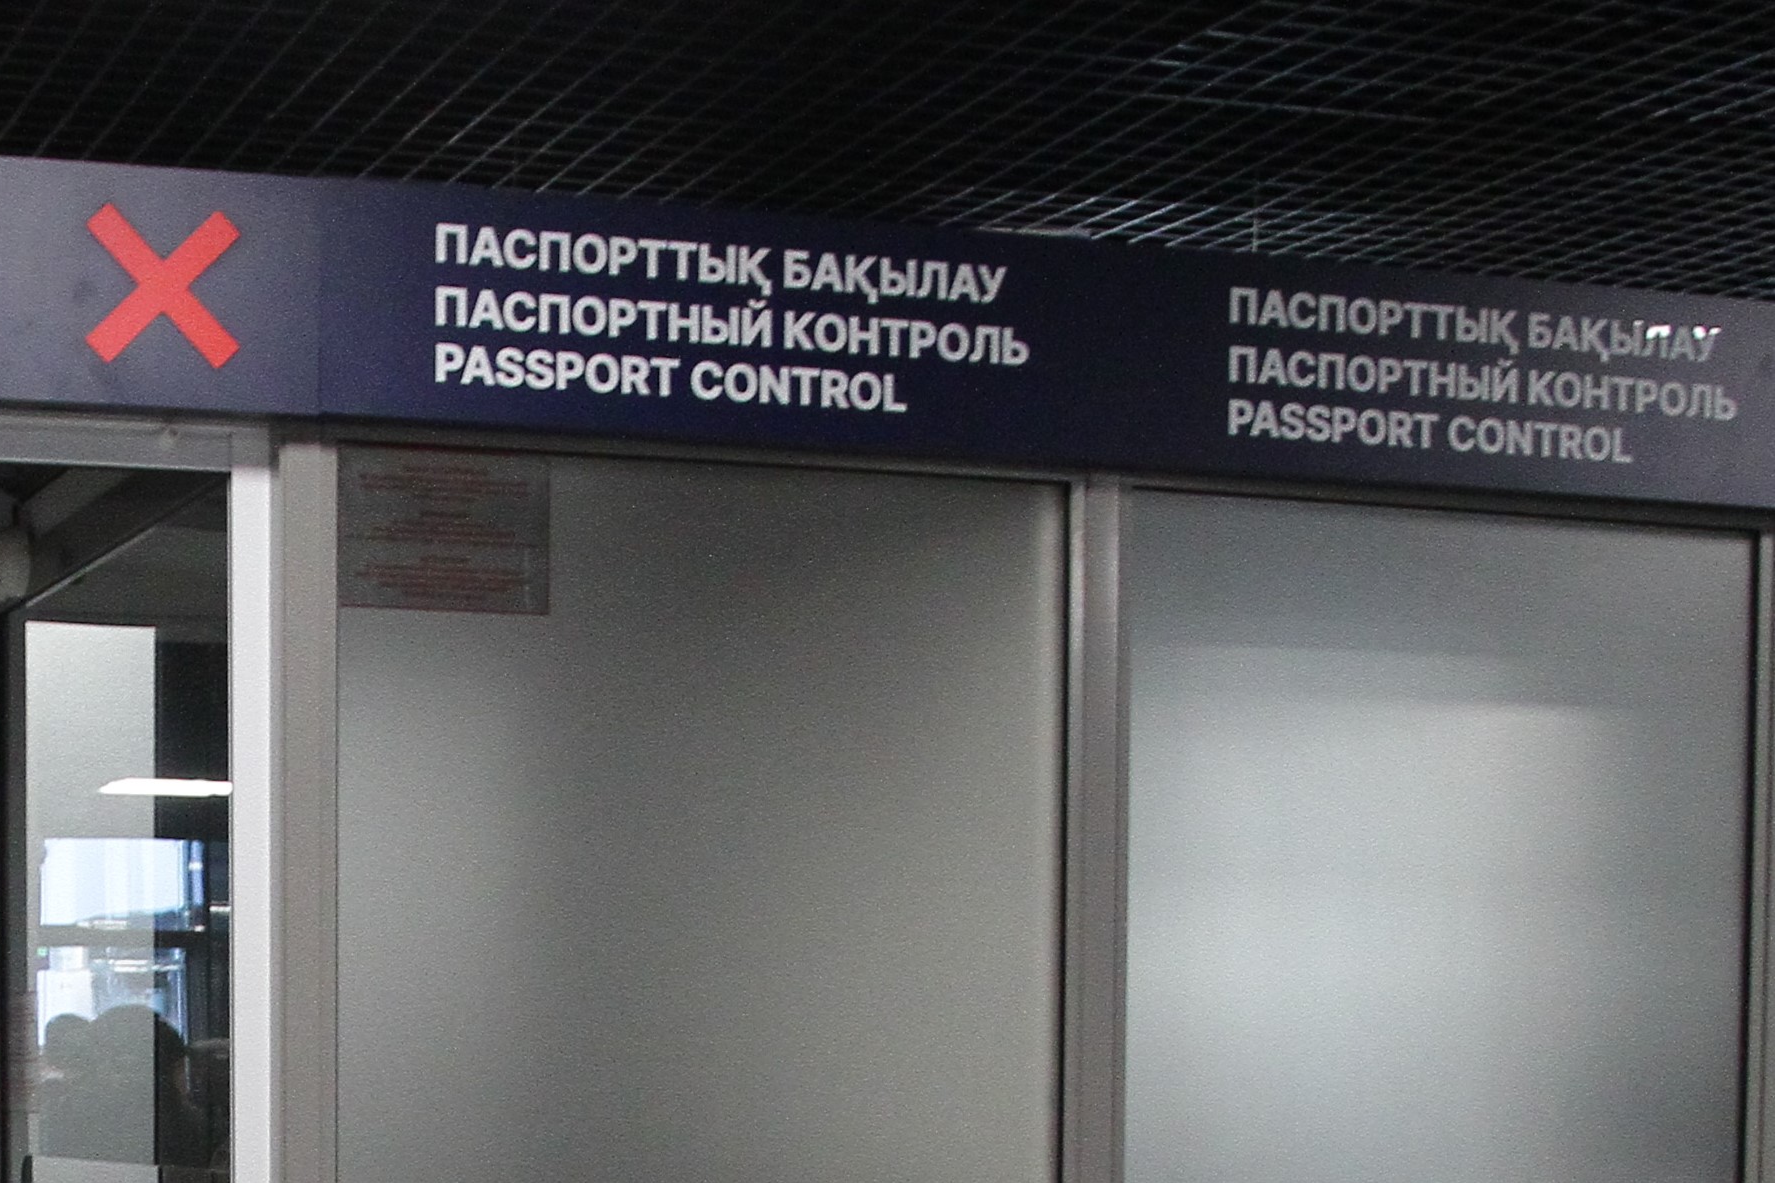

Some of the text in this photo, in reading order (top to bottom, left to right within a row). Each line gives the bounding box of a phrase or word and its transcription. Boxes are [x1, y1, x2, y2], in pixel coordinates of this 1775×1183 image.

[435, 222, 1006, 304] ПАСПОРТТЫҚ БАҚЫЛАУ
[435, 286, 1029, 365] ПАСПОРТНЫЙ КОНТРОЛЬ
[1229, 286, 1722, 362] ПАСПОРТТЫҚ БАҚЫЛАУ
[435, 343, 908, 412] PASSPORT CONTROL
[1229, 345, 1739, 422] ПАСПОРТНЫЙ КОНТРОЛЬ
[1228, 399, 1634, 464] PASSPORT CONTROL
